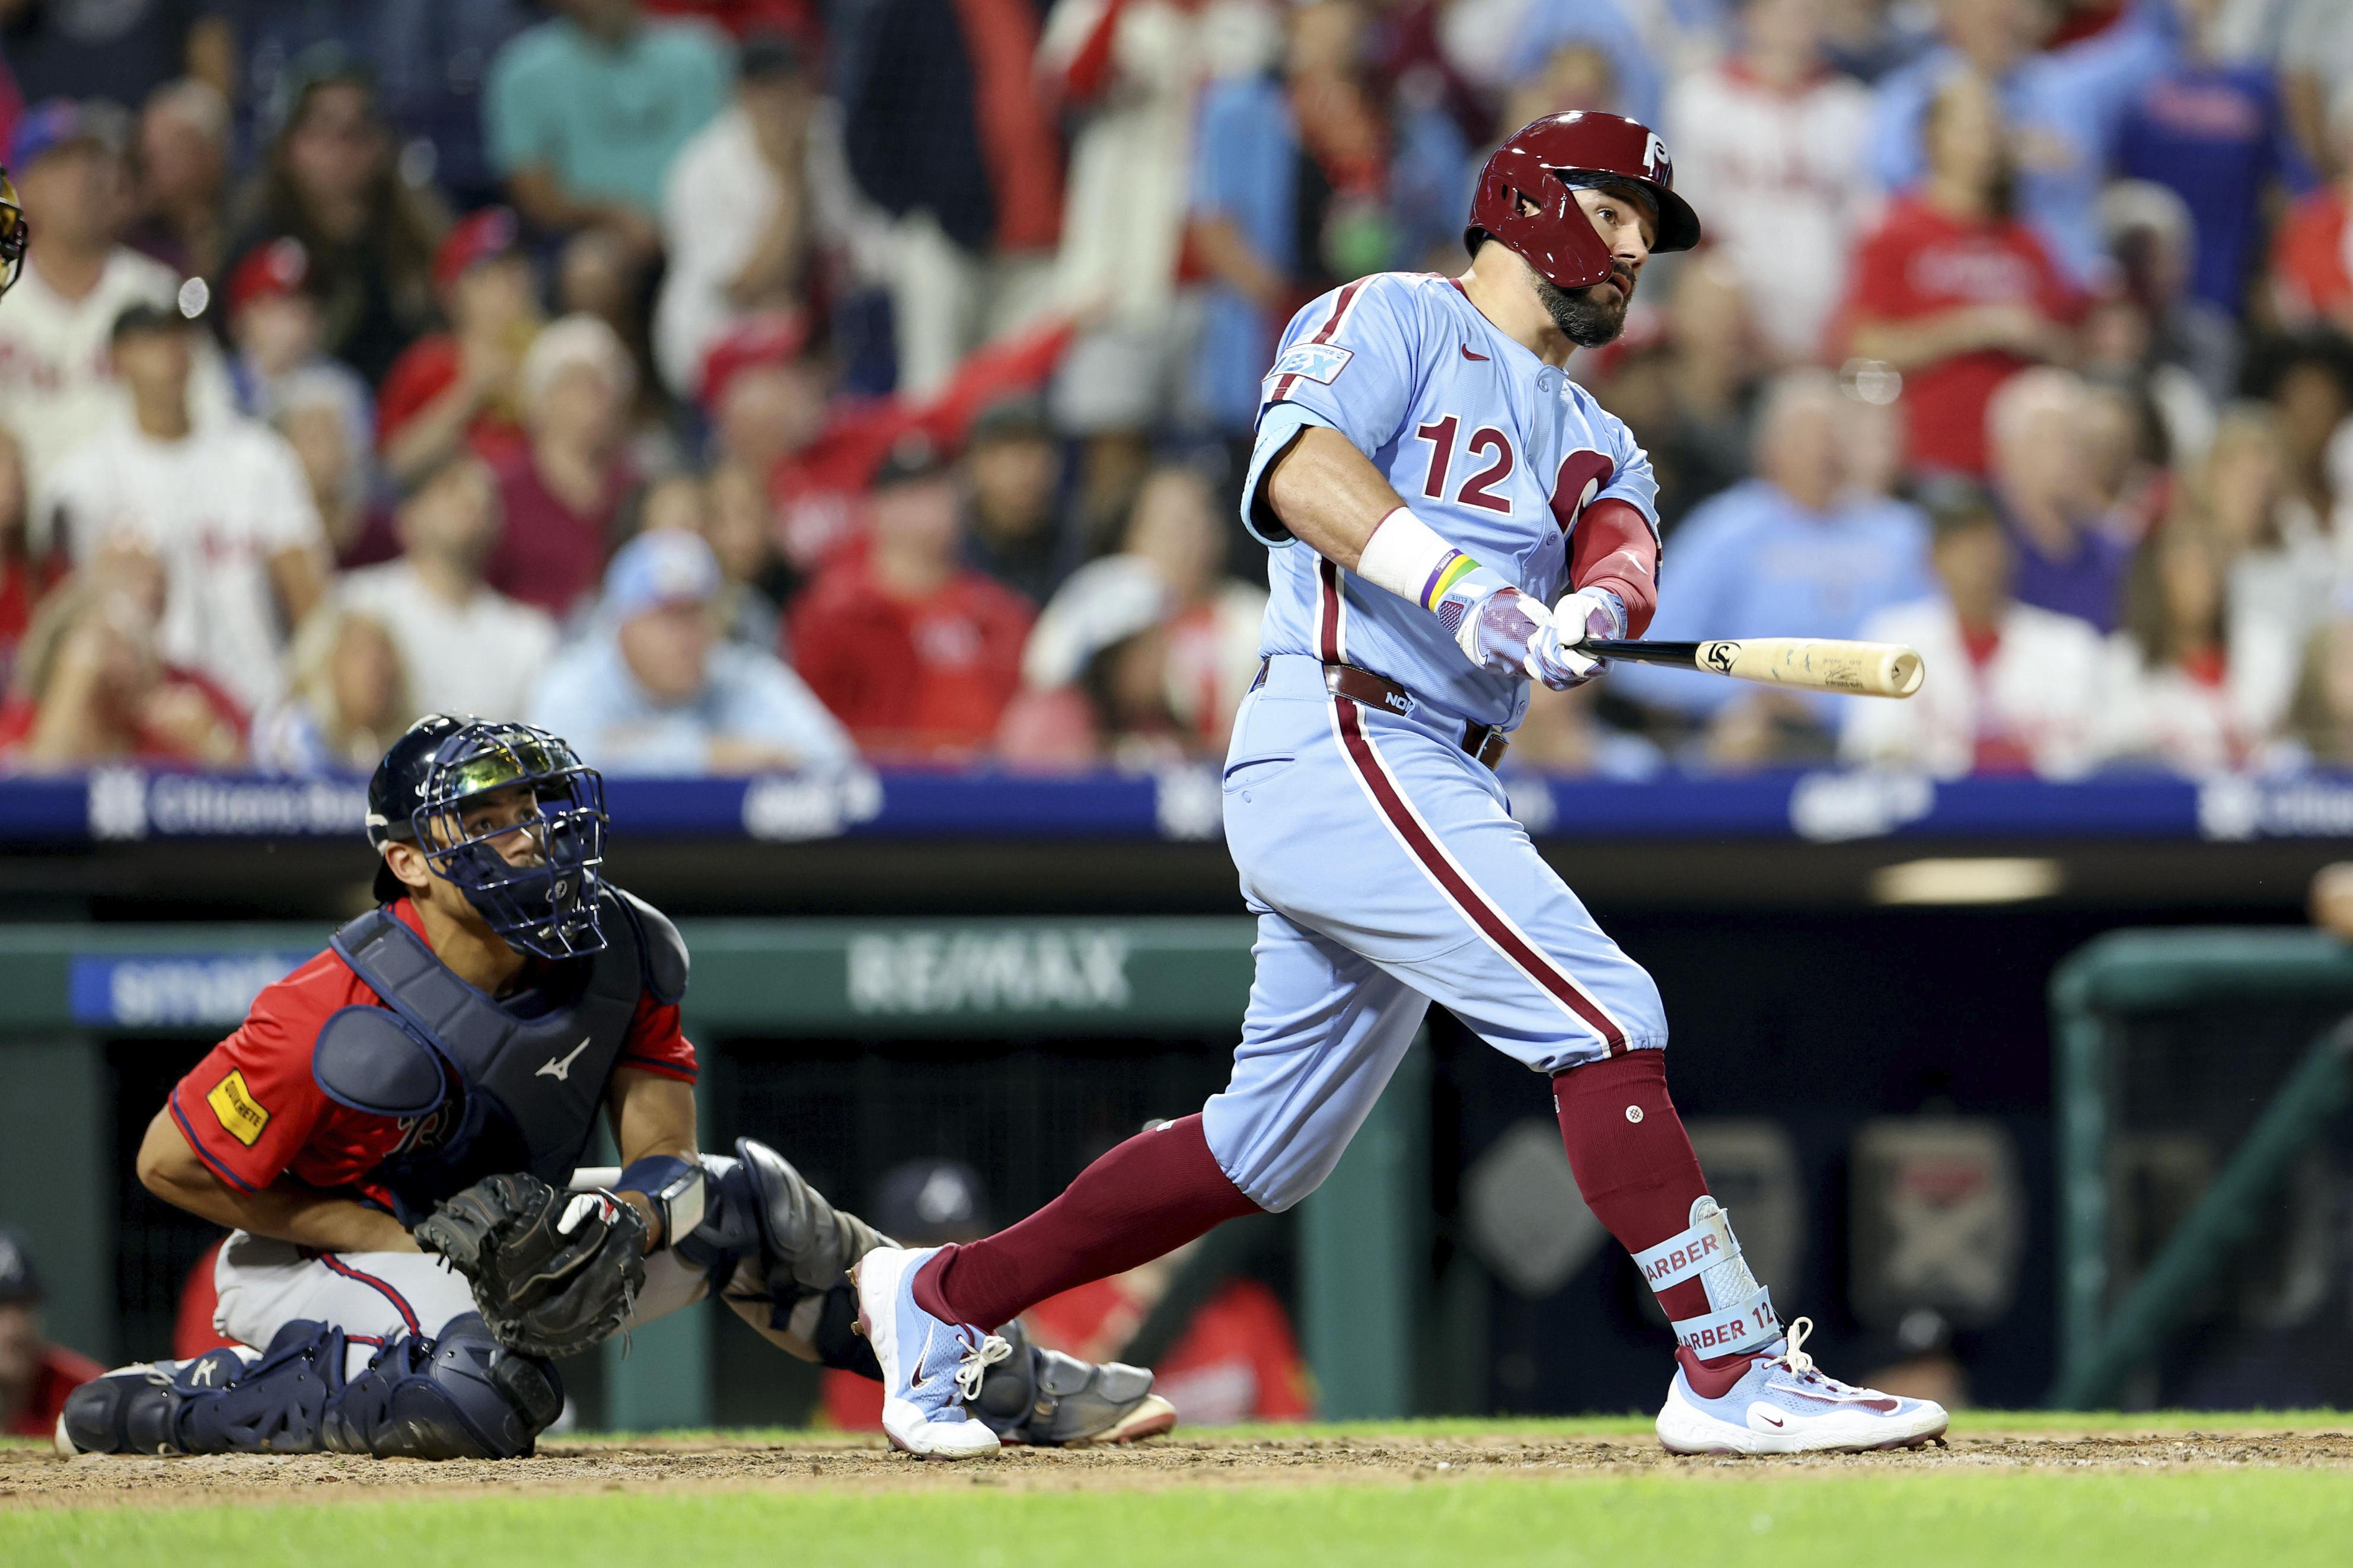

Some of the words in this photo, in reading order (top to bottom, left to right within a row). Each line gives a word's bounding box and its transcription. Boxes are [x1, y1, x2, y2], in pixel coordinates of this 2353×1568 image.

[1414, 413, 1513, 517] 12
[1451, 594, 1468, 603] ELITE
[1641, 1233, 1720, 1283] ARBER
[1679, 1319, 1747, 1351] ARBER
[1752, 1301, 1774, 1329] 12
